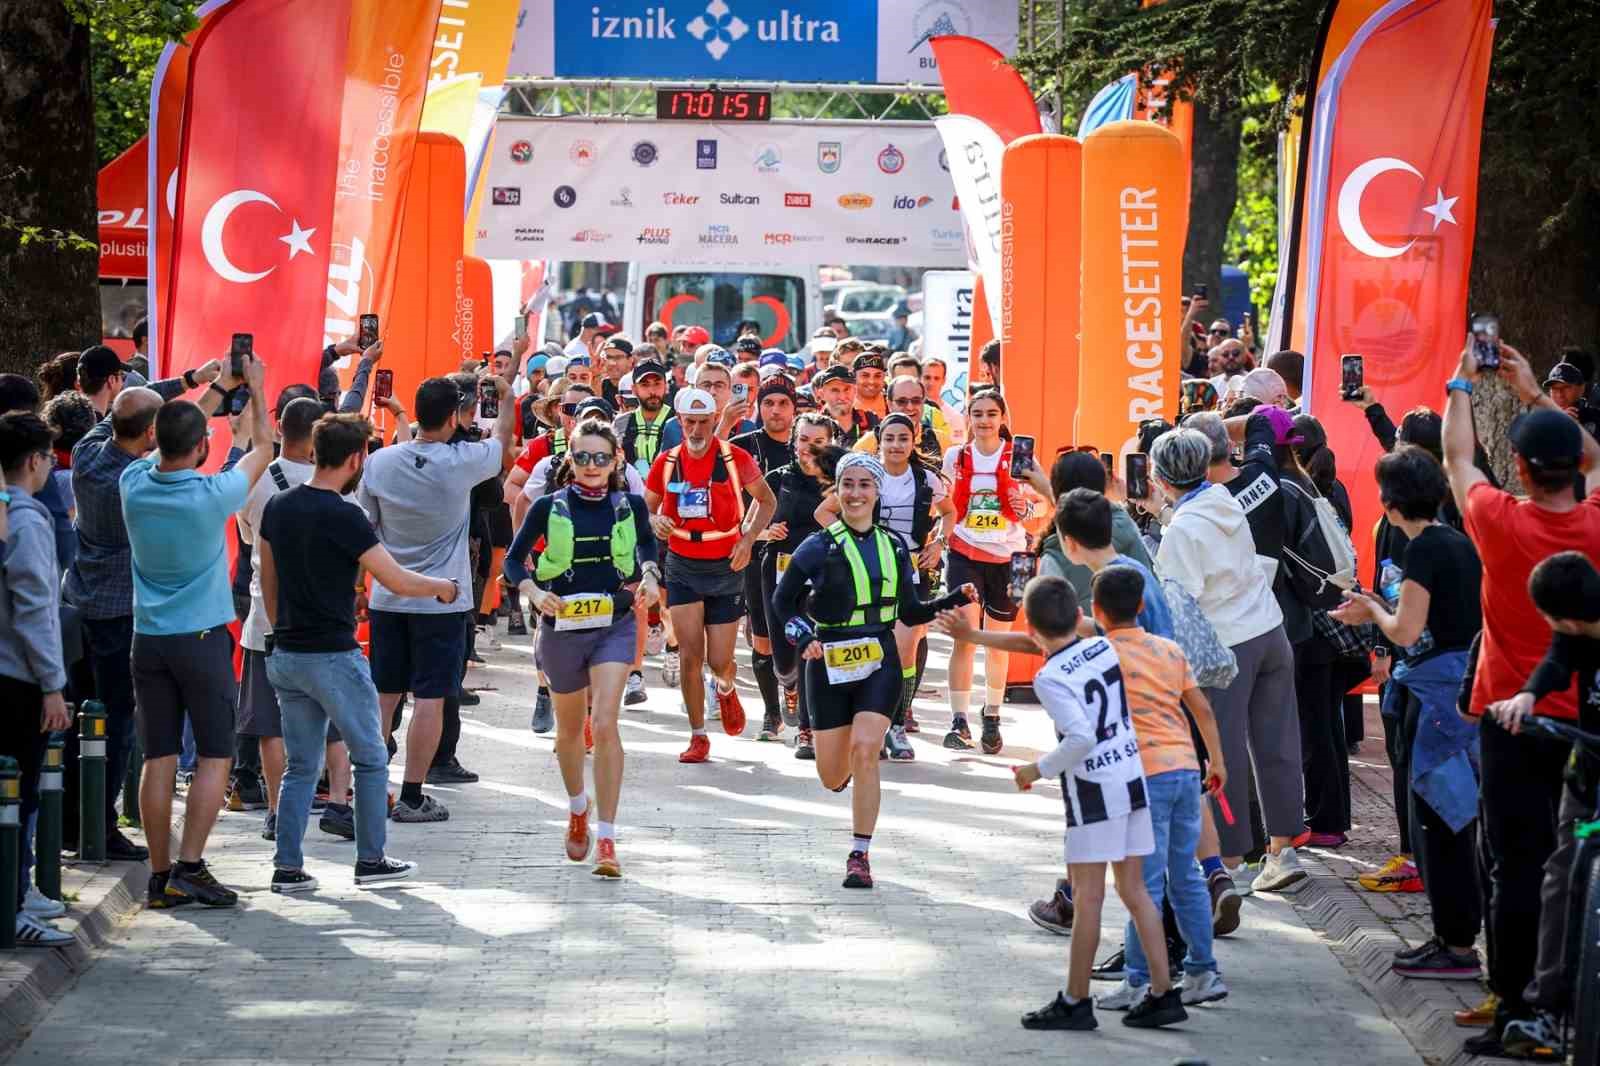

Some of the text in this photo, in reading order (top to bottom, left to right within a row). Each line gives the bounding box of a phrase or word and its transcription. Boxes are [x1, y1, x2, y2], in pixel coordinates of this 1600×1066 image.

[591, 7, 840, 43] iznik ultra
[670, 92, 767, 118] 17:01:51
[719, 193, 760, 206] Sultan
[893, 195, 916, 209] ido
[1119, 187, 1165, 423] RACESETTER
[976, 515, 999, 528] 214
[574, 600, 601, 614] 217
[843, 645, 870, 662] 201
[1084, 663, 1130, 745] 27
[1085, 749, 1122, 772] RAFA
